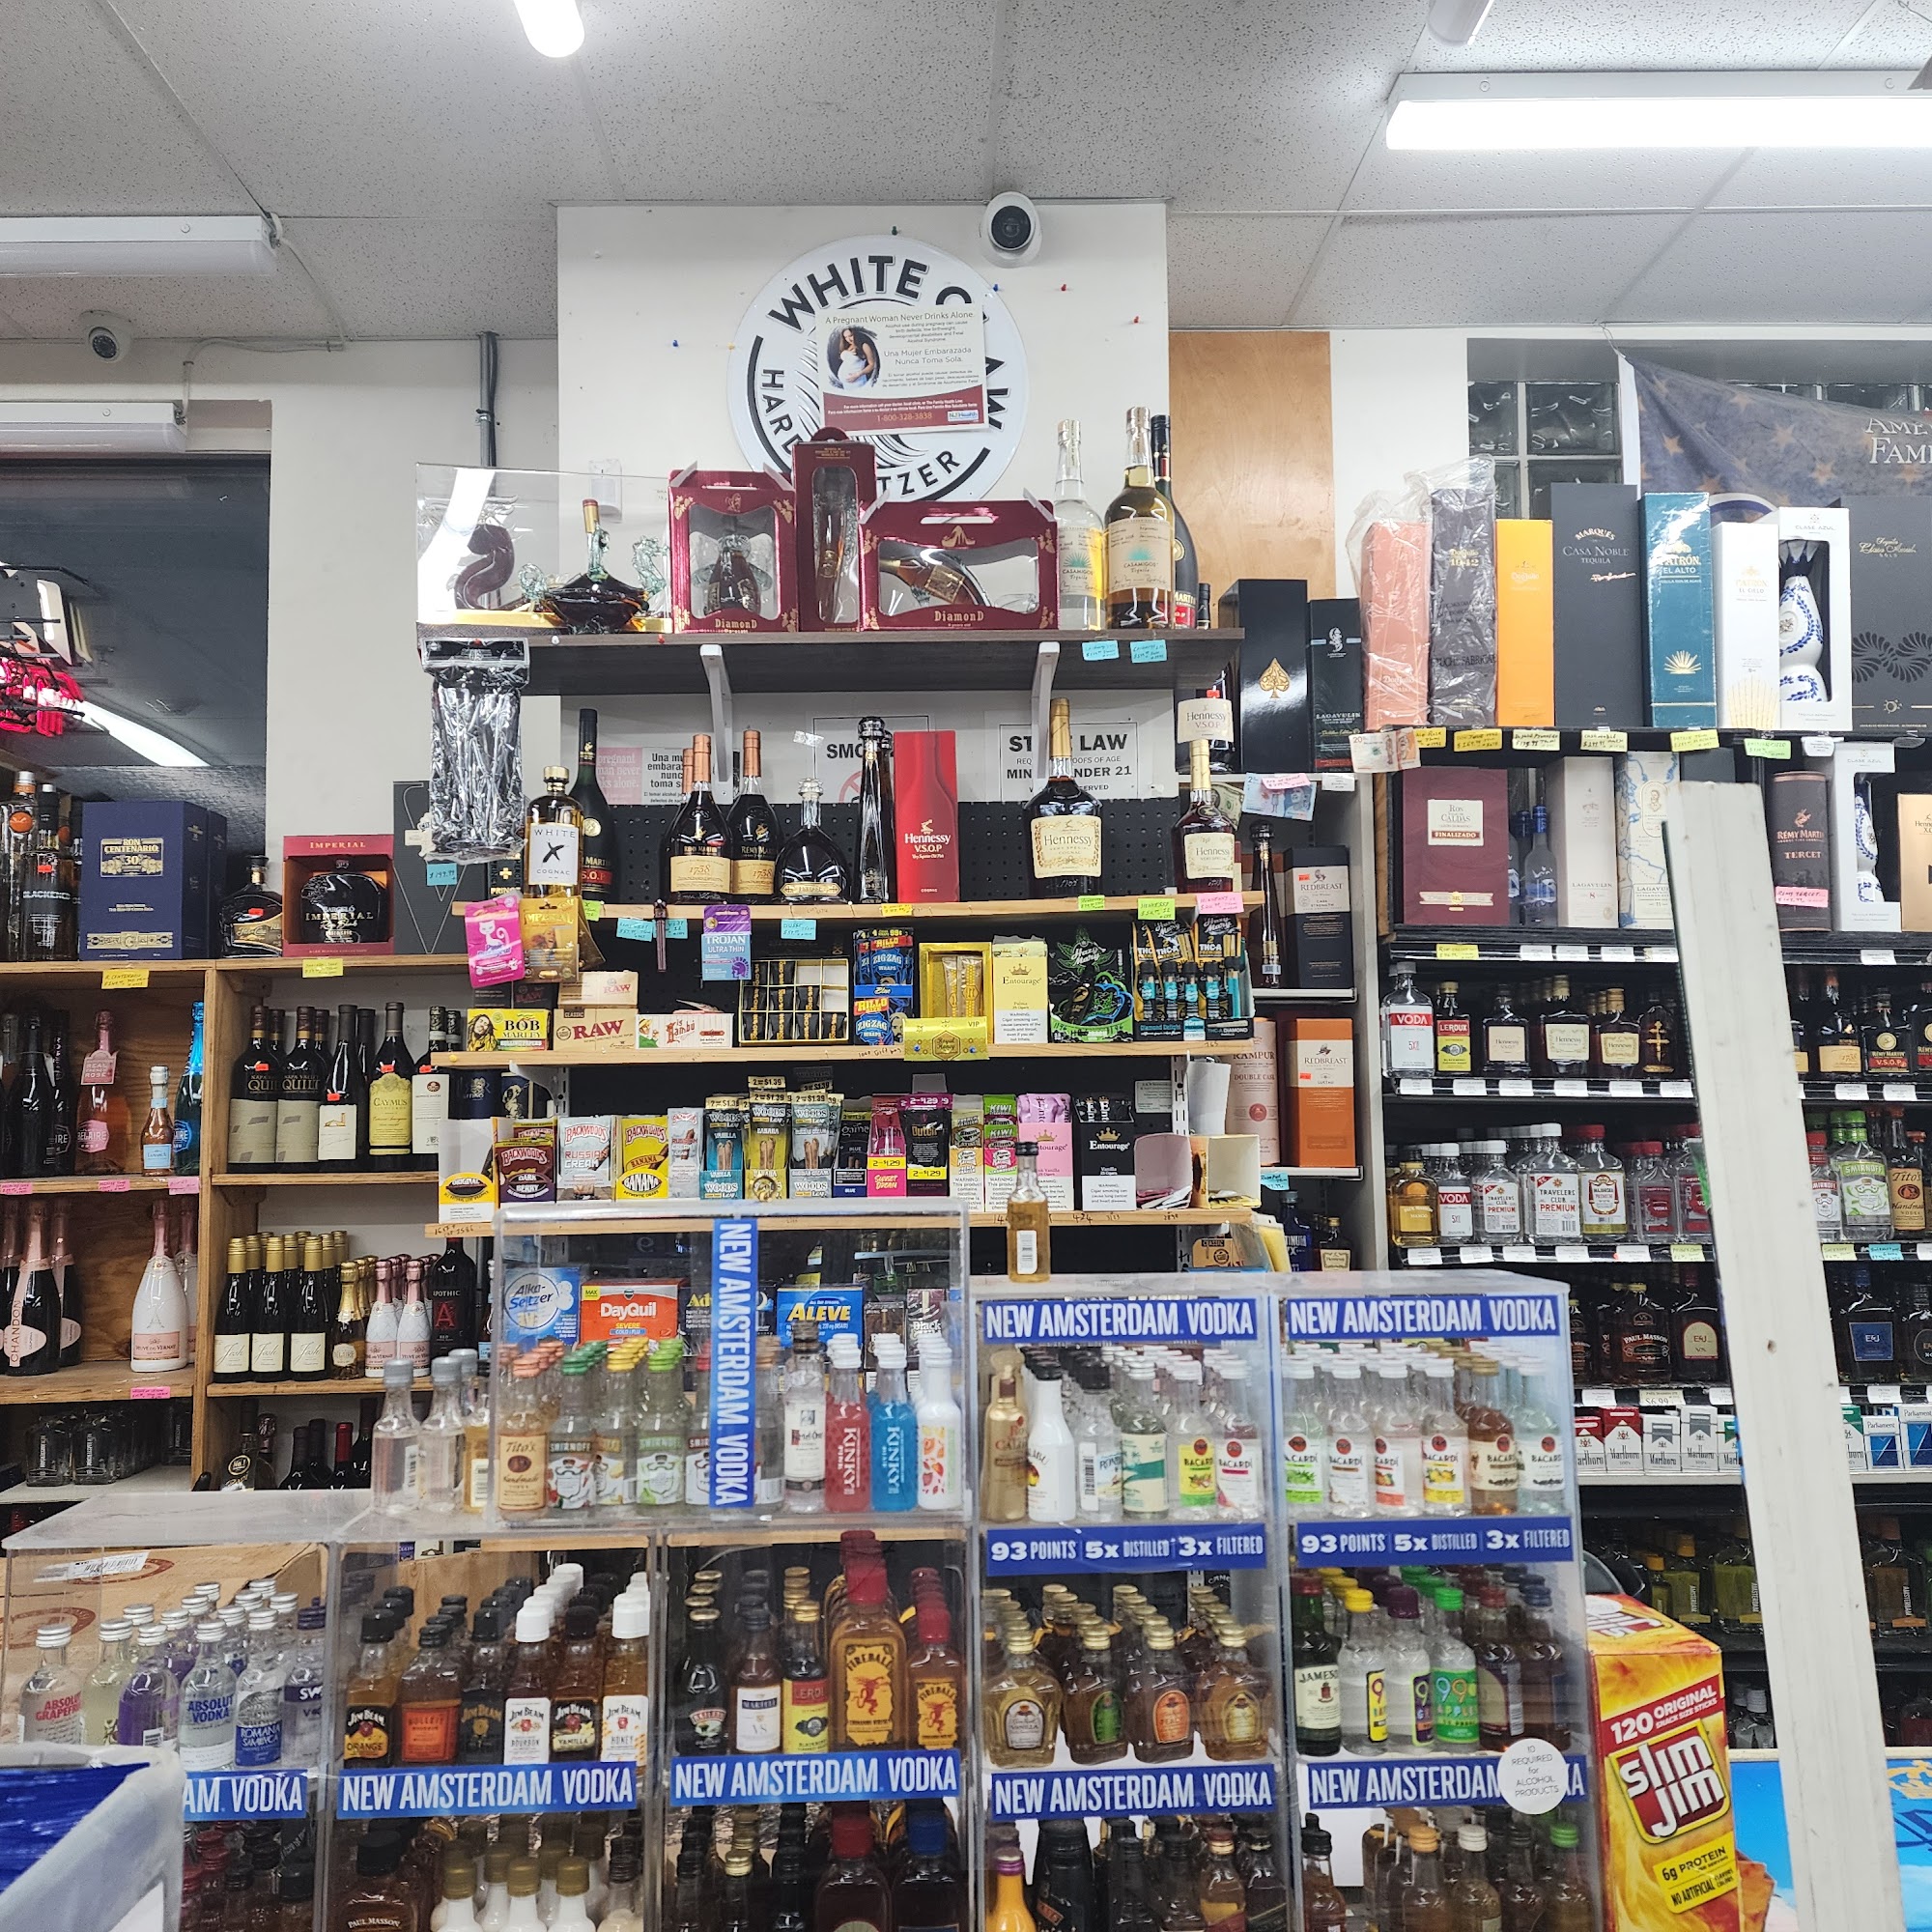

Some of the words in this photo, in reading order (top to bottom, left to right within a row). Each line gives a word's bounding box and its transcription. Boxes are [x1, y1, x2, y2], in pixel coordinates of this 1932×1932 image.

[767, 256, 928, 331] WHITE
[833, 316, 867, 325] Pregnant
[901, 349, 922, 357] Mujer
[877, 412, 932, 422] 1-800-328-3838
[1563, 546, 1592, 556] CASA
[1595, 546, 1630, 556] NOBLE
[1186, 710, 1226, 723] Hennessy
[1080, 734, 1127, 751] LAW
[652, 753, 668, 762] Una
[1116, 766, 1131, 775] 21
[611, 778, 639, 787] alone.
[1441, 813, 1471, 823] CALDAS
[533, 829, 576, 839] WHITE
[904, 833, 951, 845] Hennessy
[1043, 834, 1093, 847] Hennessy
[103, 844, 159, 853] CENTENARIO
[1784, 850, 1822, 859] TERCET
[1300, 883, 1344, 892] REDBREAST
[704, 935, 746, 945] TROJAN
[707, 945, 728, 953] ULTRA
[730, 945, 745, 953] THIN
[1003, 977, 1039, 985] Entourage
[603, 984, 631, 994] RAW
[504, 1020, 540, 1031] BOB
[1396, 1014, 1430, 1024] VODA
[572, 1020, 624, 1039] RAW
[1304, 1056, 1349, 1065] REDBREAST
[282, 1078, 320, 1091] QUILT
[373, 1097, 408, 1107] CAYMUS
[752, 1108, 785, 1117] WOODS
[565, 1124, 609, 1145] BACKWOODS
[626, 1124, 667, 1145] BACKWOODS
[1090, 1141, 1128, 1151] Entourage
[501, 1148, 547, 1166] BACKWOODS
[564, 1159, 599, 1168] CREAM
[1844, 1164, 1884, 1175] SMIRNOFF
[624, 1175, 660, 1192] BANANA
[704, 1183, 738, 1192] WOODS
[794, 1183, 827, 1192] WOODS
[1439, 1193, 1470, 1204] VODA
[1539, 1188, 1576, 1197] TRAVELERS
[1540, 1204, 1577, 1212] PREMIUM
[719, 1222, 751, 1274] NEW
[510, 1293, 553, 1310] Seltzer
[600, 1302, 657, 1319] DayQuil
[787, 1306, 851, 1321] ALEVE
[1291, 1302, 1338, 1335] NEW
[1343, 1298, 1482, 1334] AMSTERDAM
[1490, 1298, 1556, 1331] VODKA
[986, 1305, 1033, 1338] NEW
[1038, 1301, 1179, 1337] AMSTERDAM
[1187, 1301, 1254, 1334] VODKA
[9, 1298, 20, 1364] CHANDON
[1624, 1333, 1642, 1344] PAUL
[1643, 1333, 1668, 1344] MASSON
[718, 1275, 751, 1424] AMSTERDAM
[1866, 1421, 1895, 1430] Parliament
[505, 1440, 536, 1454] Tito's
[1650, 1451, 1677, 1465] Marlboro
[715, 1434, 749, 1507] VODKA
[1301, 1534, 1338, 1555] 93
[1340, 1533, 1385, 1553] POINTS
[1432, 1532, 1477, 1551] DISTILLED
[1522, 1528, 1570, 1549] FILTERED
[991, 1541, 1028, 1562] 93
[1030, 1540, 1076, 1560] POINTS
[1122, 1538, 1171, 1557] DISTILLED
[1216, 1535, 1264, 1556] FILTERED
[847, 1653, 893, 1671] FIREBALL
[920, 1687, 956, 1700] FIREBALL
[186, 1694, 233, 1712] ABSOLUT
[193, 1709, 230, 1722] VODKA
[1610, 1712, 1654, 1745] 120
[1654, 1685, 1717, 1719] ORIGINAL
[347, 1743, 384, 1752] ORANGE
[1511, 1753, 1552, 1766] REQUIRED
[676, 1763, 726, 1798] NEW
[731, 1758, 879, 1797] AMSTERDAM
[888, 1756, 957, 1791] VODKA
[1517, 1776, 1555, 1786] ALCOHOL
[342, 1776, 395, 1811] NEW
[399, 1772, 551, 1809] AMSTERDAM
[562, 1769, 634, 1804] VODKA
[1312, 1769, 1361, 1804] NEW
[1515, 1784, 1559, 1797] PRODUCTS
[232, 1776, 302, 1812] VODKA
[995, 1780, 1046, 1815] NEW
[1050, 1775, 1194, 1811] AMSTERDAM
[1202, 1772, 1271, 1805] VODKA
[1662, 1868, 1678, 1881] 6g
[1679, 1847, 1726, 1873] PROTEIN
[1671, 1890, 1683, 1906] NO
[1683, 1879, 1716, 1901] ARTIFICIAL
